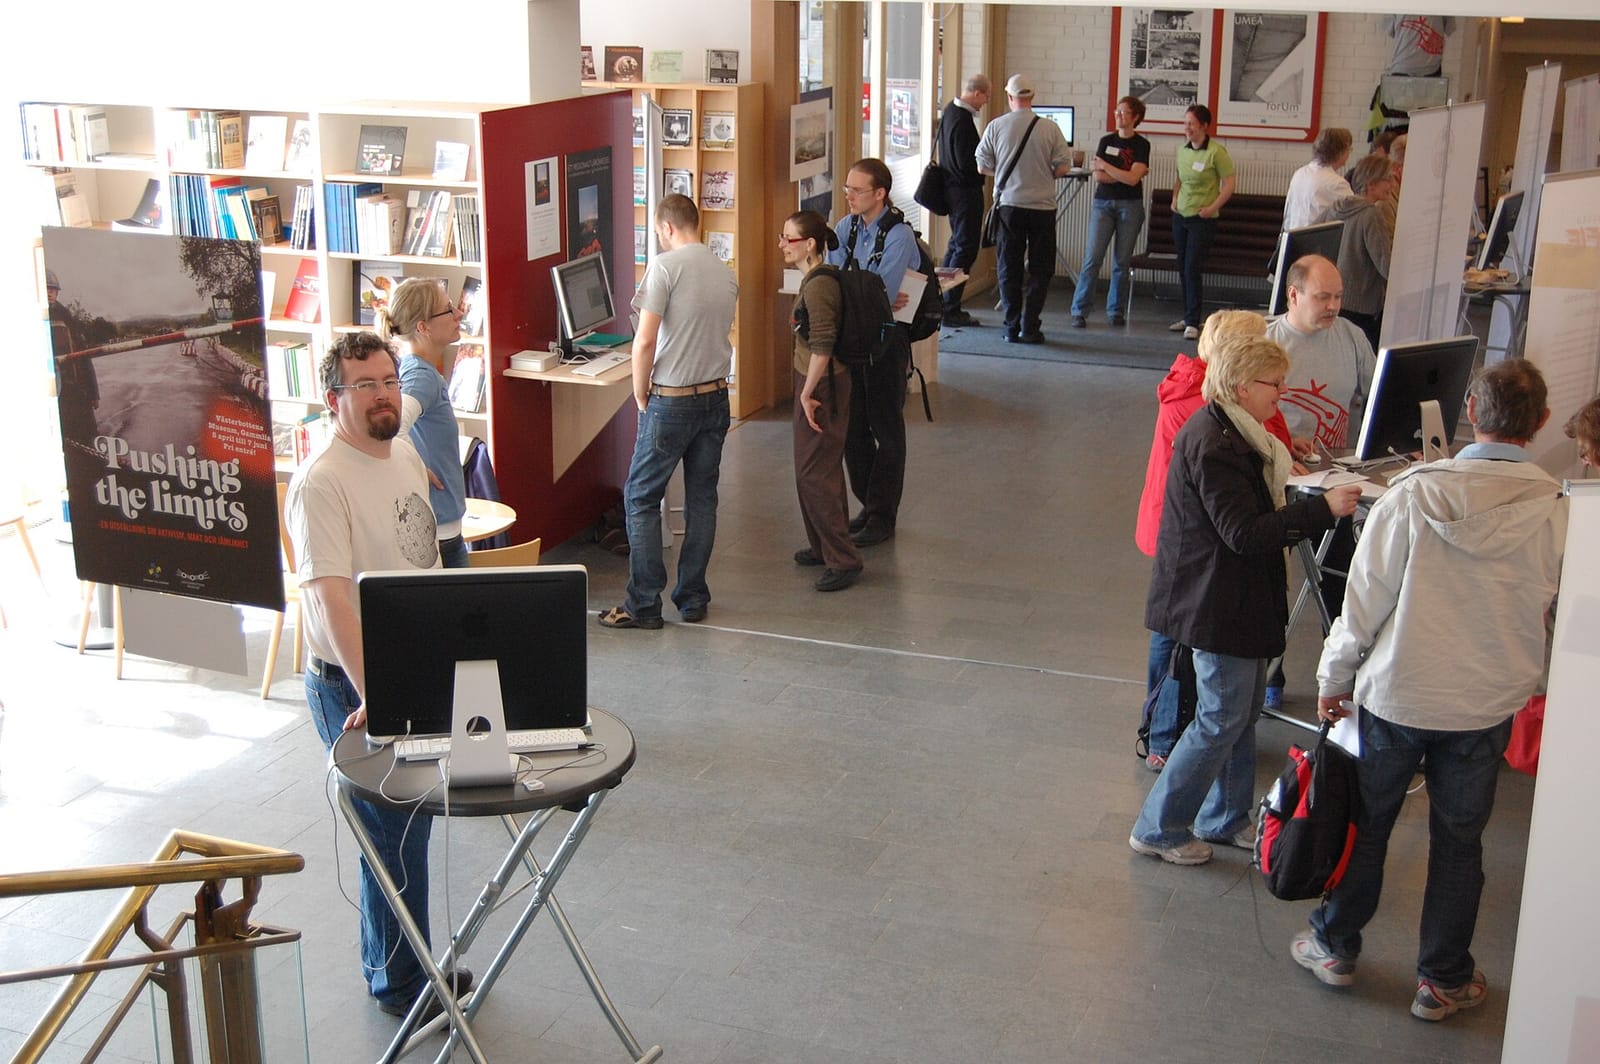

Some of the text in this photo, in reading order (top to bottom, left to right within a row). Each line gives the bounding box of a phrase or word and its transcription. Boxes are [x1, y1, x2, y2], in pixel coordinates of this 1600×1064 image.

[94, 435, 241, 494] Pushing
[96, 474, 248, 533] the limits
